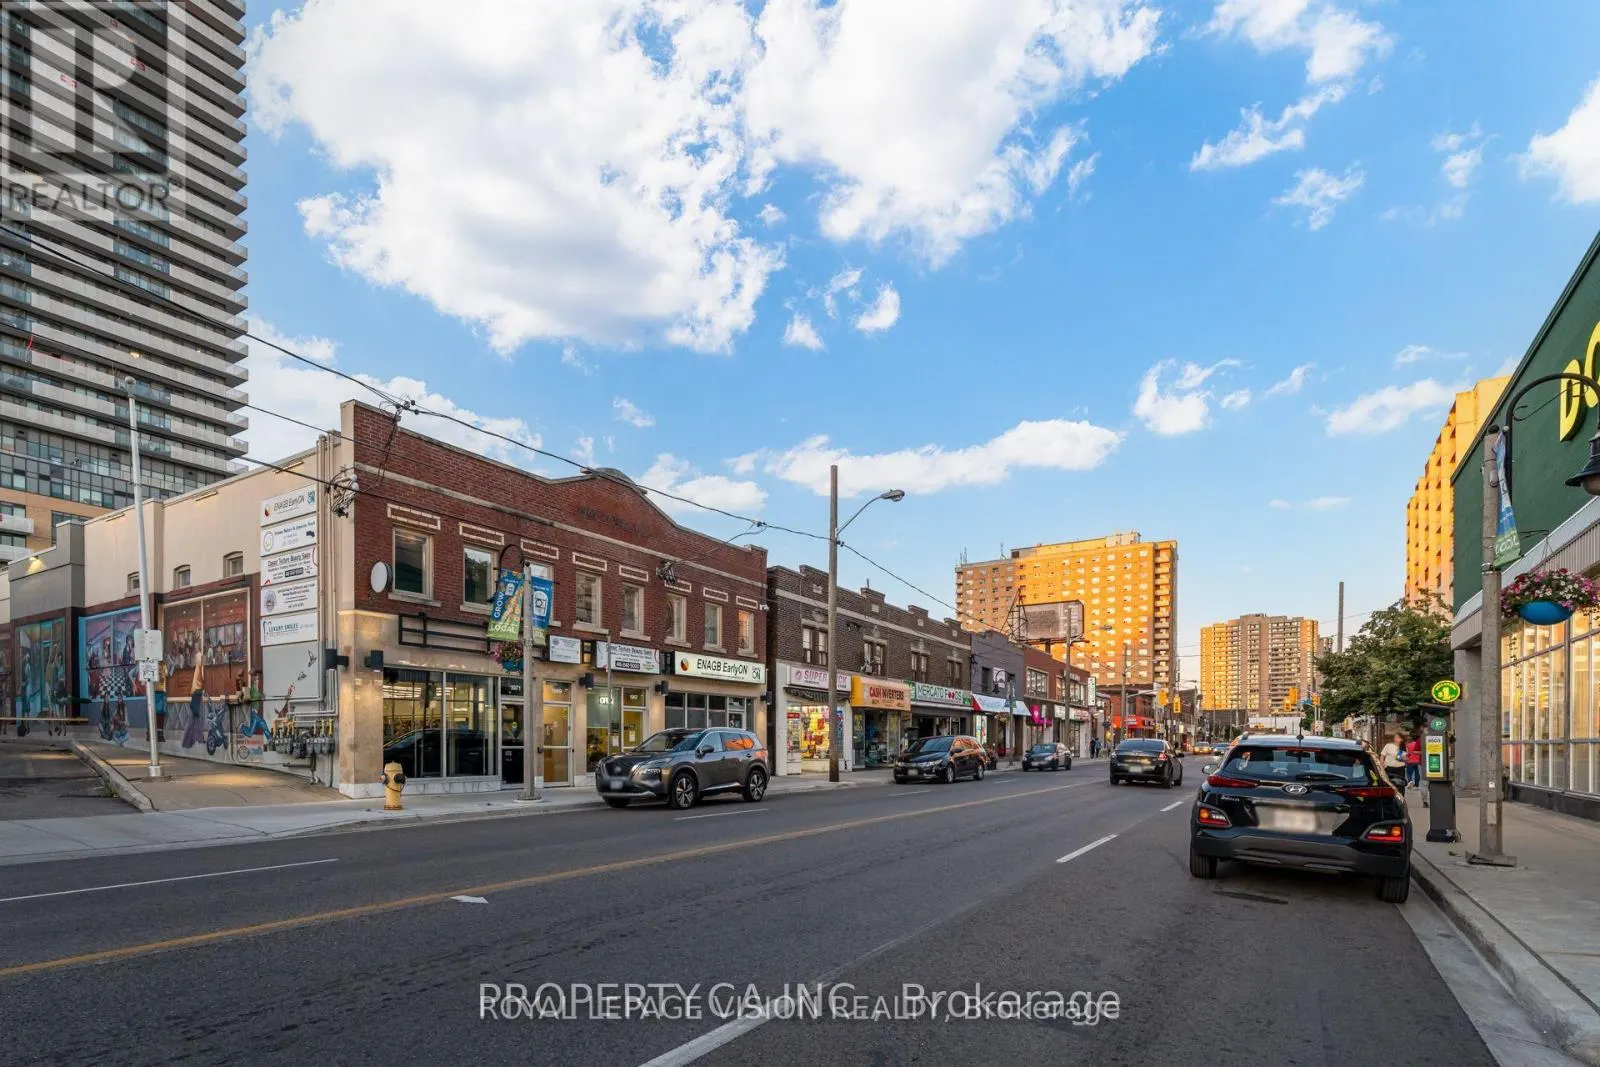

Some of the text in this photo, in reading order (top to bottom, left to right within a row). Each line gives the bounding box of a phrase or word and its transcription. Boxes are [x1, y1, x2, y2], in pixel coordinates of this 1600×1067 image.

[493, 591, 505, 618] GROW
[489, 624, 517, 633] LOCAL
[697, 659, 721, 672] ENAGB
[722, 662, 748, 676] EarlyON
[803, 670, 828, 681] SUPER
[869, 686, 881, 699] CASH
[918, 685, 944, 698] MERCATO
